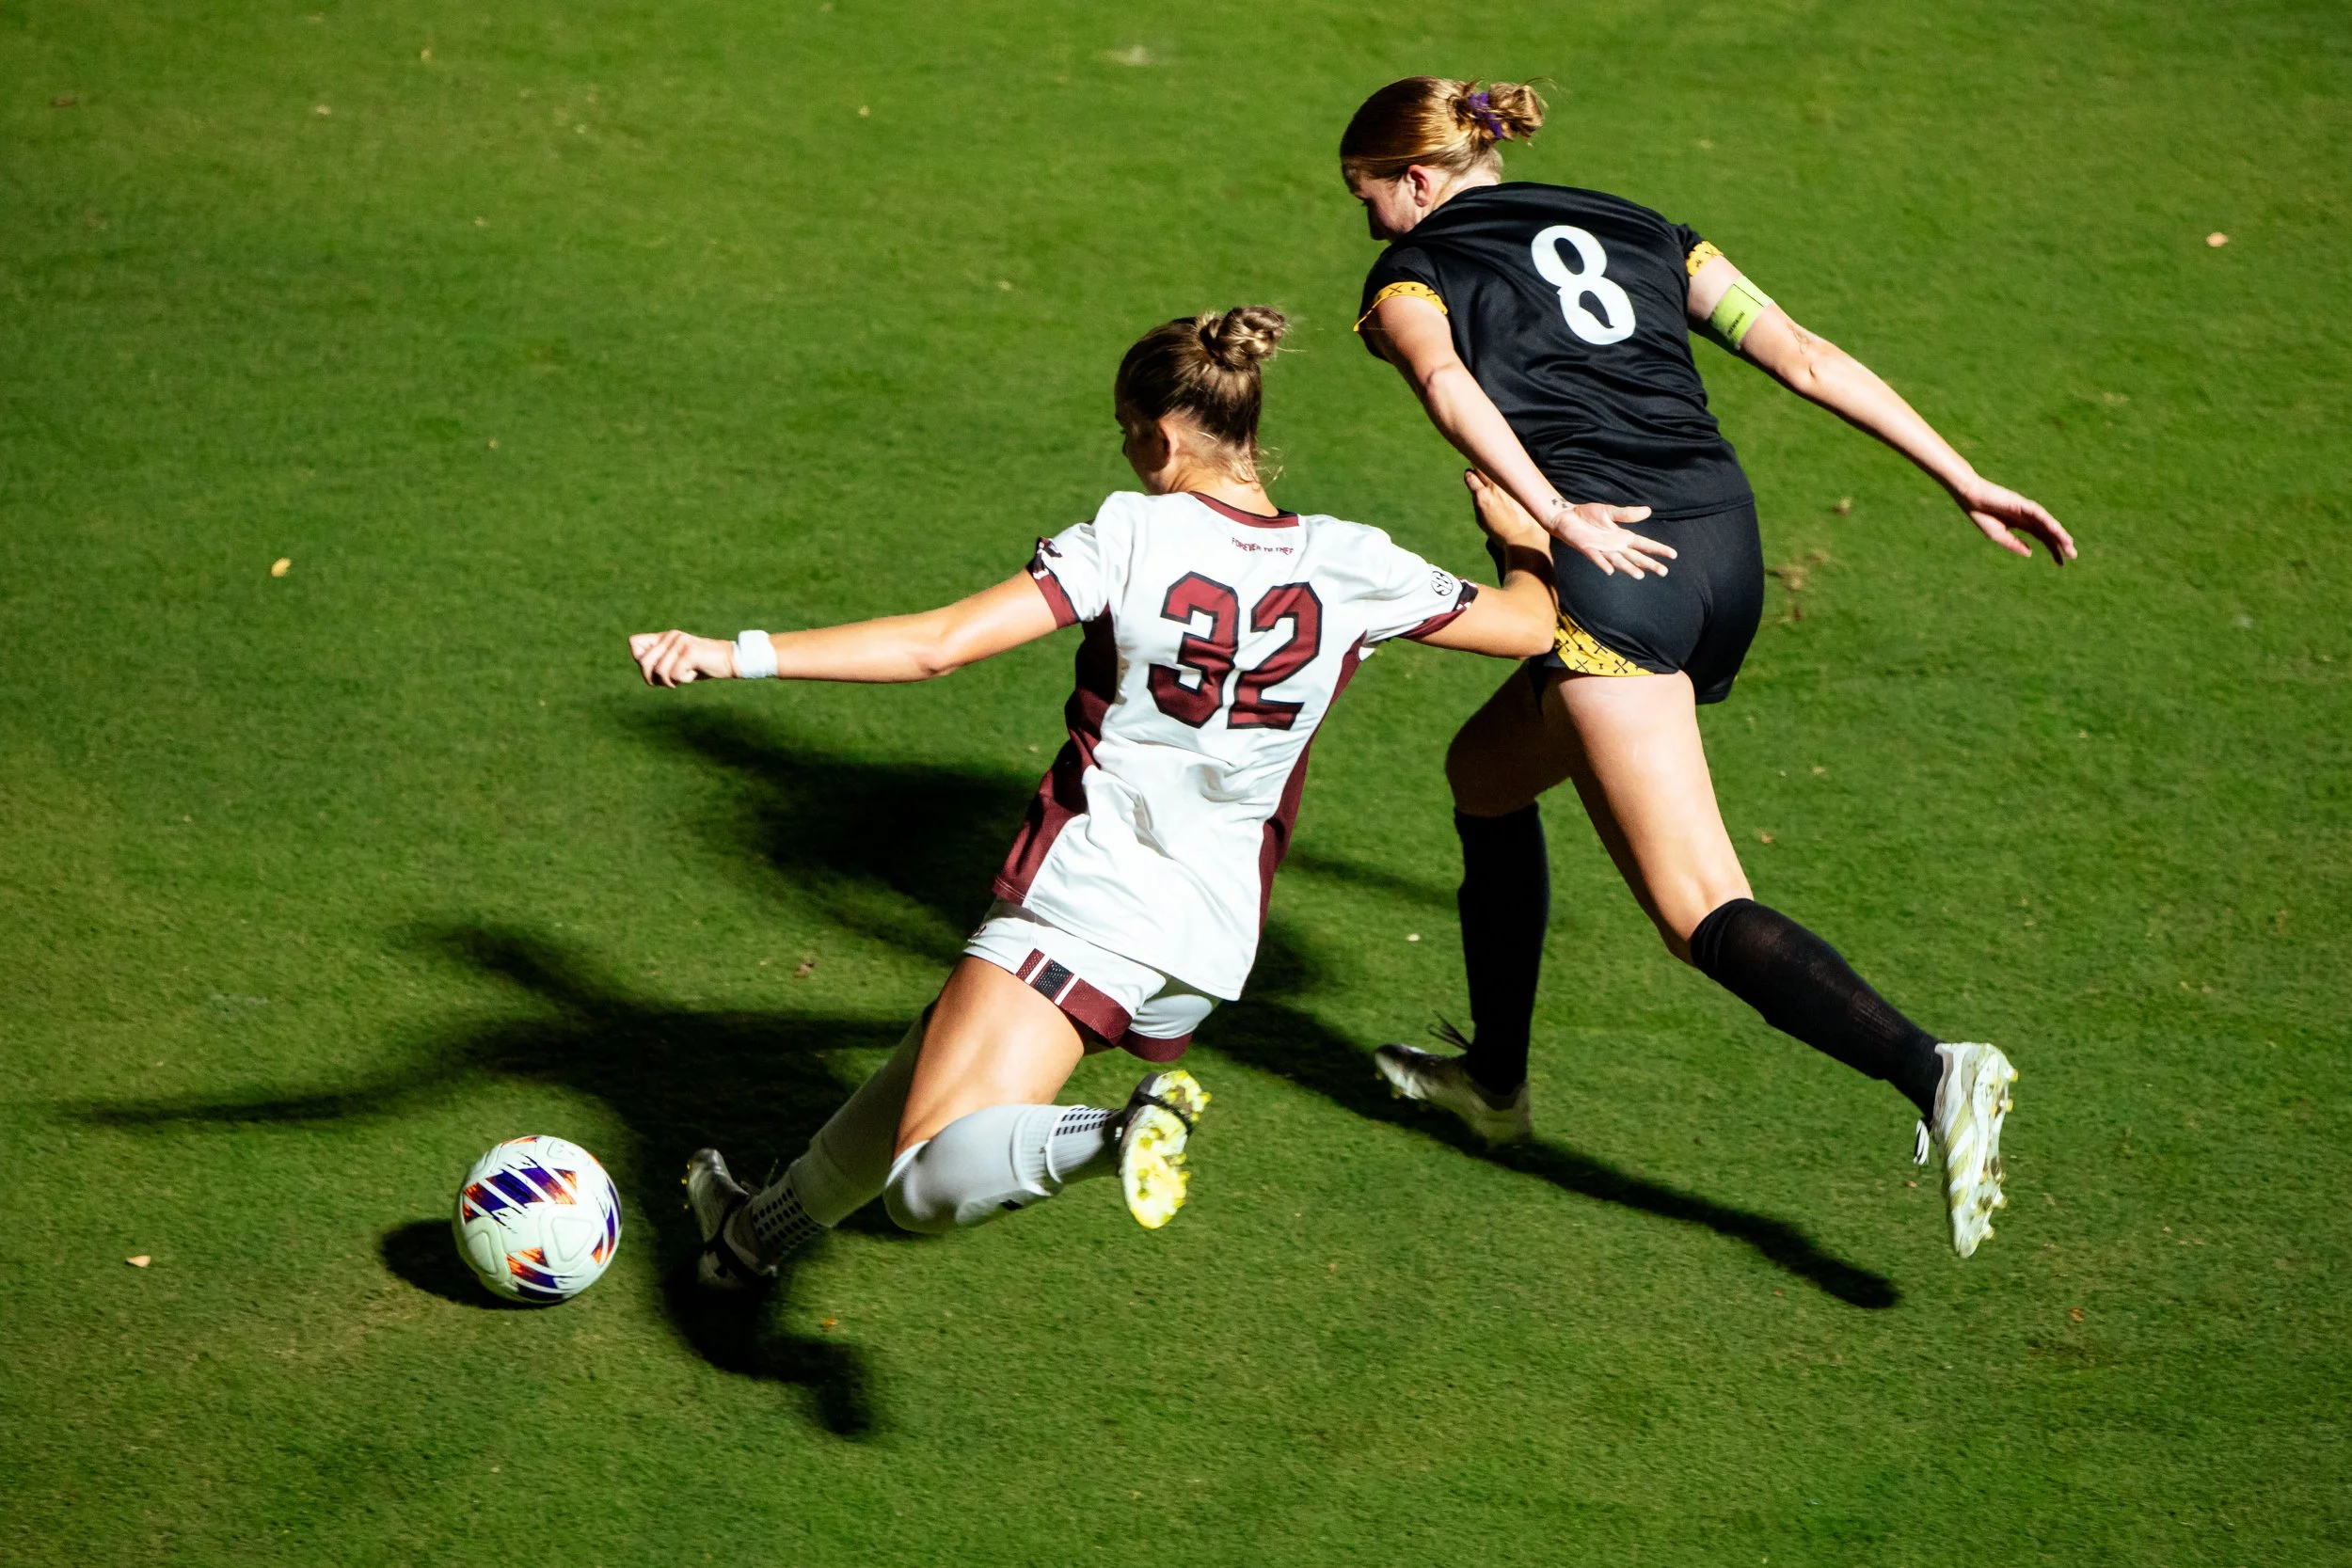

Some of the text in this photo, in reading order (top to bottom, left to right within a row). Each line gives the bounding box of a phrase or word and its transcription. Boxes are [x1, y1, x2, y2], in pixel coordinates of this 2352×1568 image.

[1531, 225, 1636, 345] 8
[1232, 537, 1261, 551] FOREVER
[1146, 570, 1323, 731] 32
